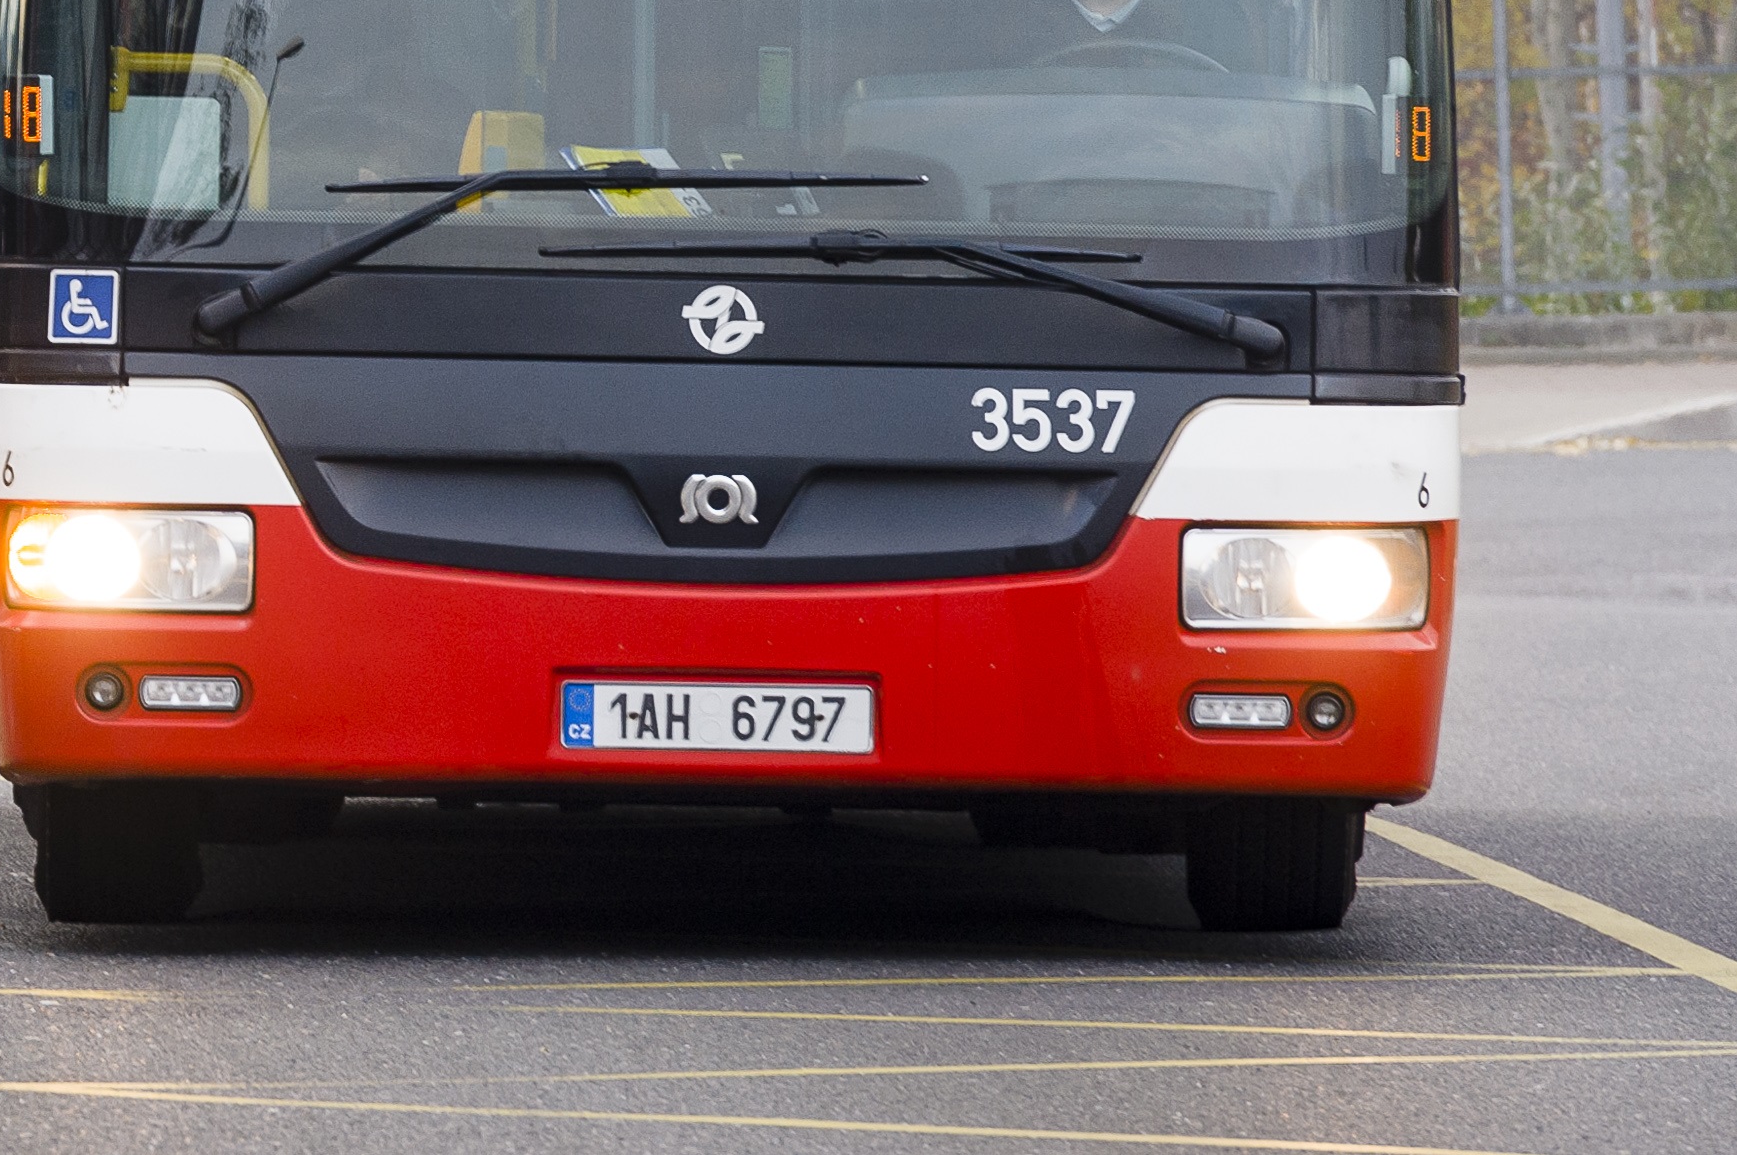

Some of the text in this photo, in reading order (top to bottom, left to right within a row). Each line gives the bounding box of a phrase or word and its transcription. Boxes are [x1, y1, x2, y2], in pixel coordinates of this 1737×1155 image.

[970, 387, 1136, 454] 3537
[2, 449, 15, 487] 6
[1417, 471, 1430, 509] 6
[568, 723, 592, 741] CZ
[610, 692, 847, 743] 1AH 6797
